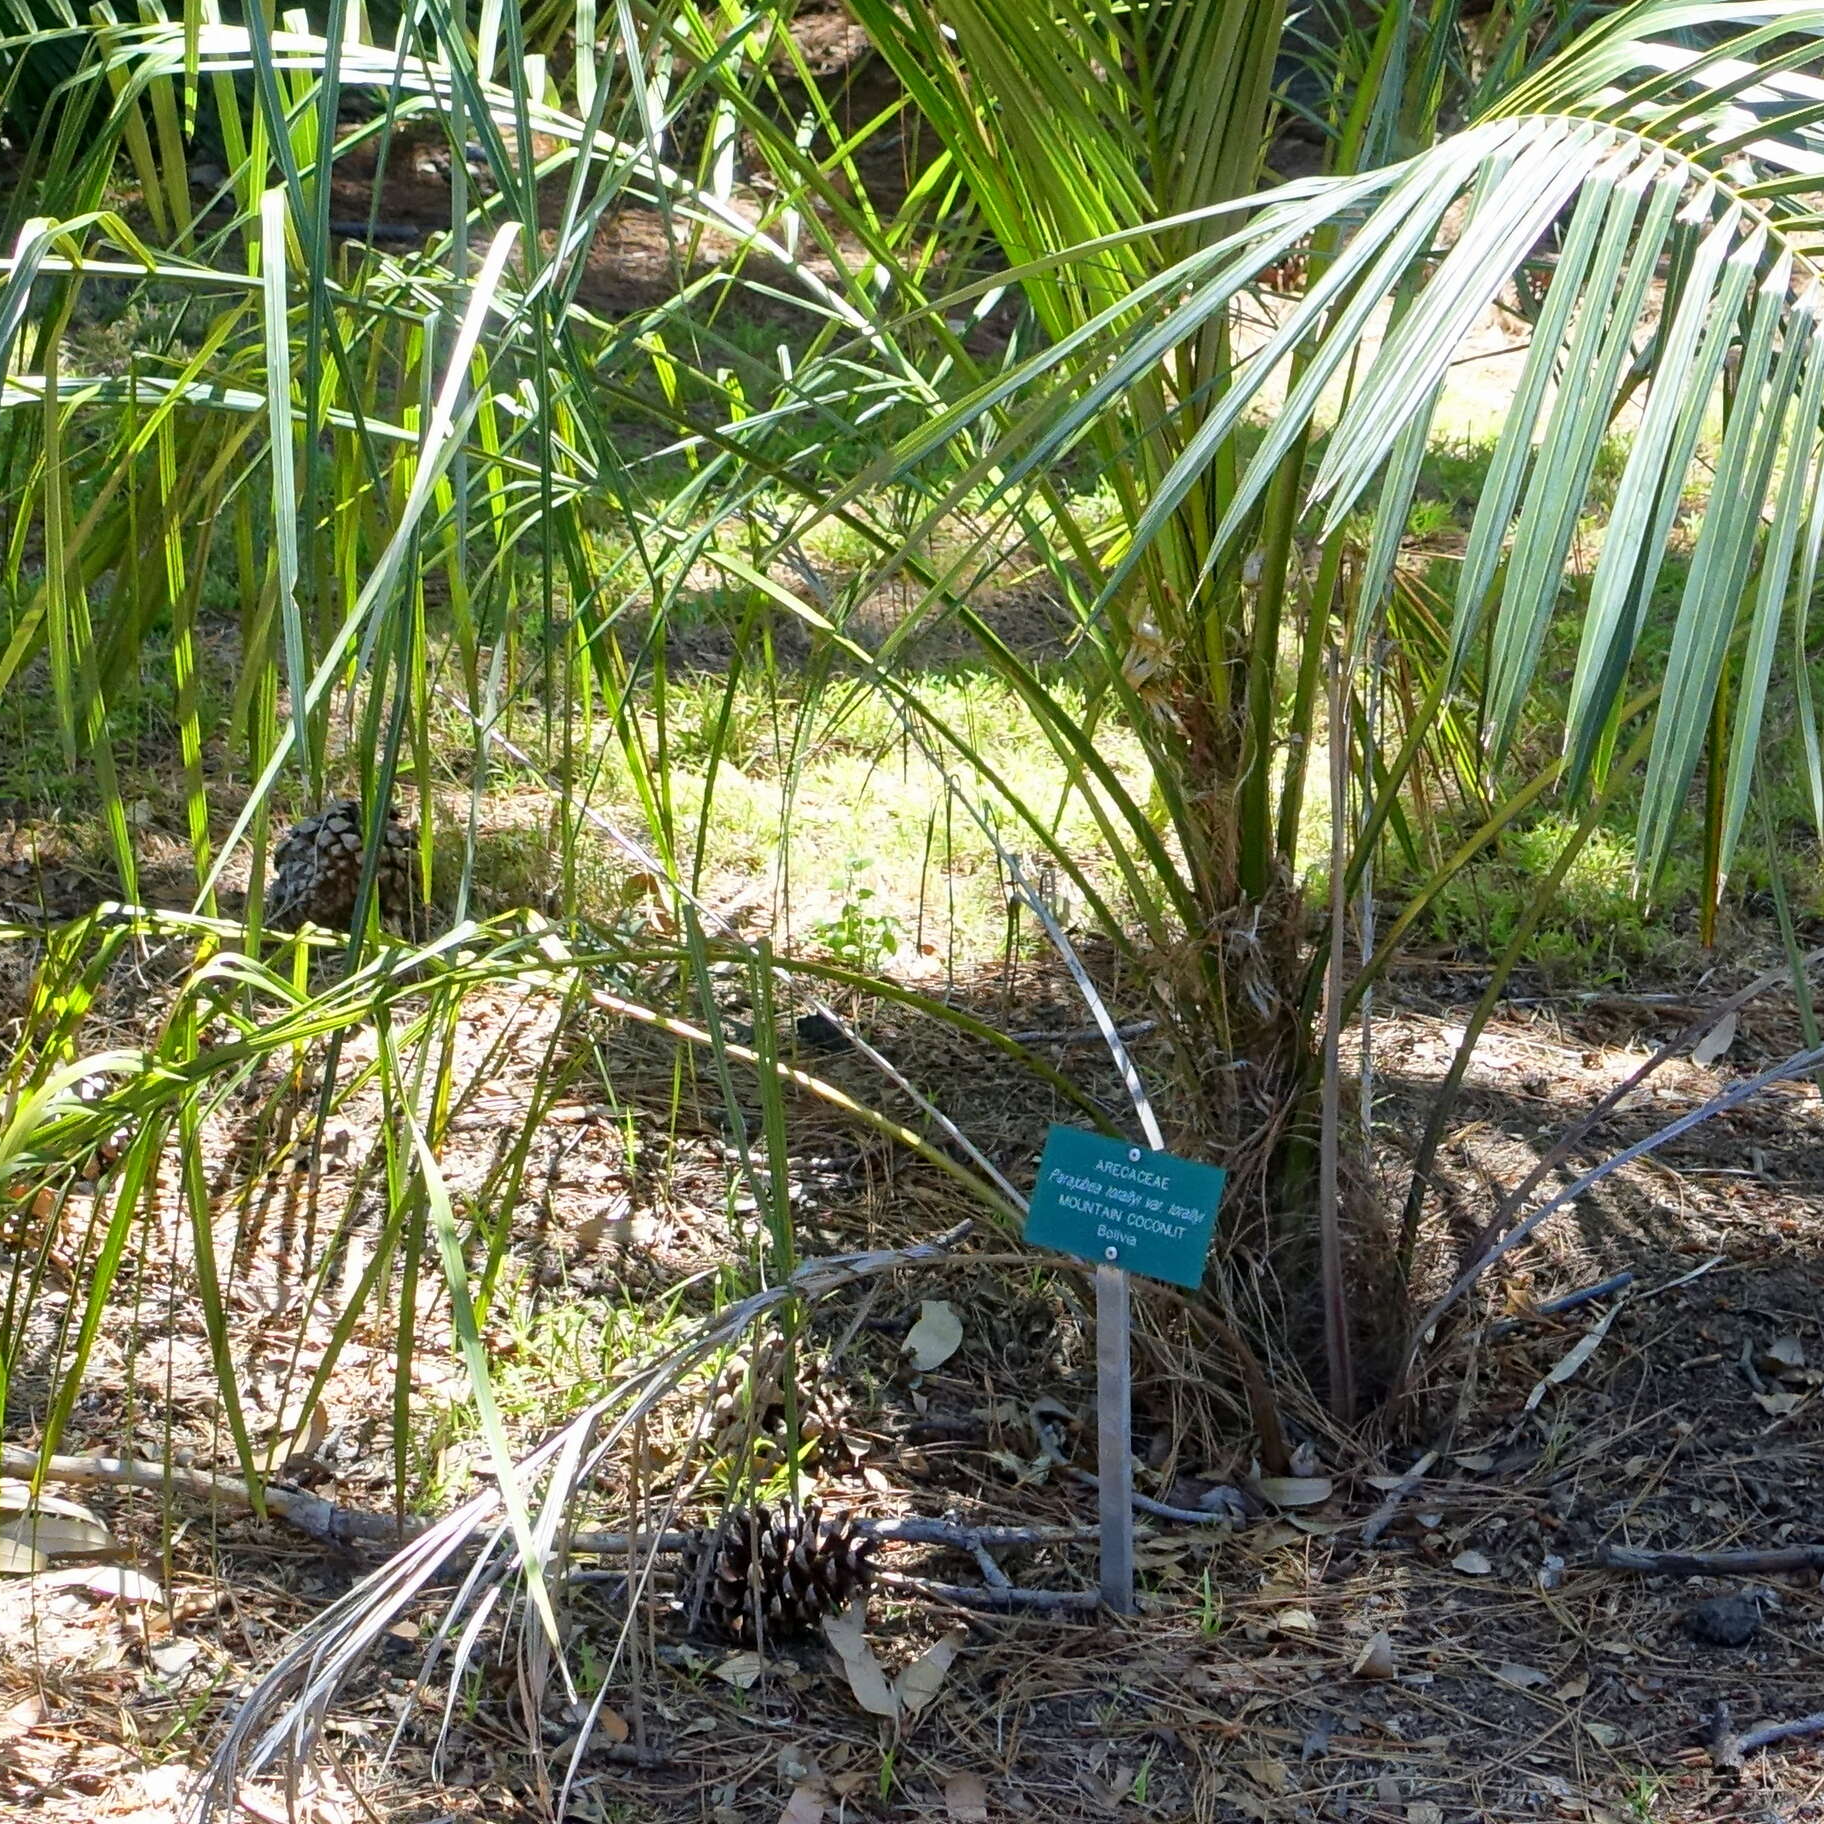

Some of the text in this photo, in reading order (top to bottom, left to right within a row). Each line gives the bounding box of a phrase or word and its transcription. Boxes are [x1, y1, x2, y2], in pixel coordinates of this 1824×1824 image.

[1095, 1159, 1170, 1191] ARECACEAE
[1058, 1193, 1187, 1240] MOUNTAIN COCONUT
[1097, 1224, 1137, 1247] Bolivia
